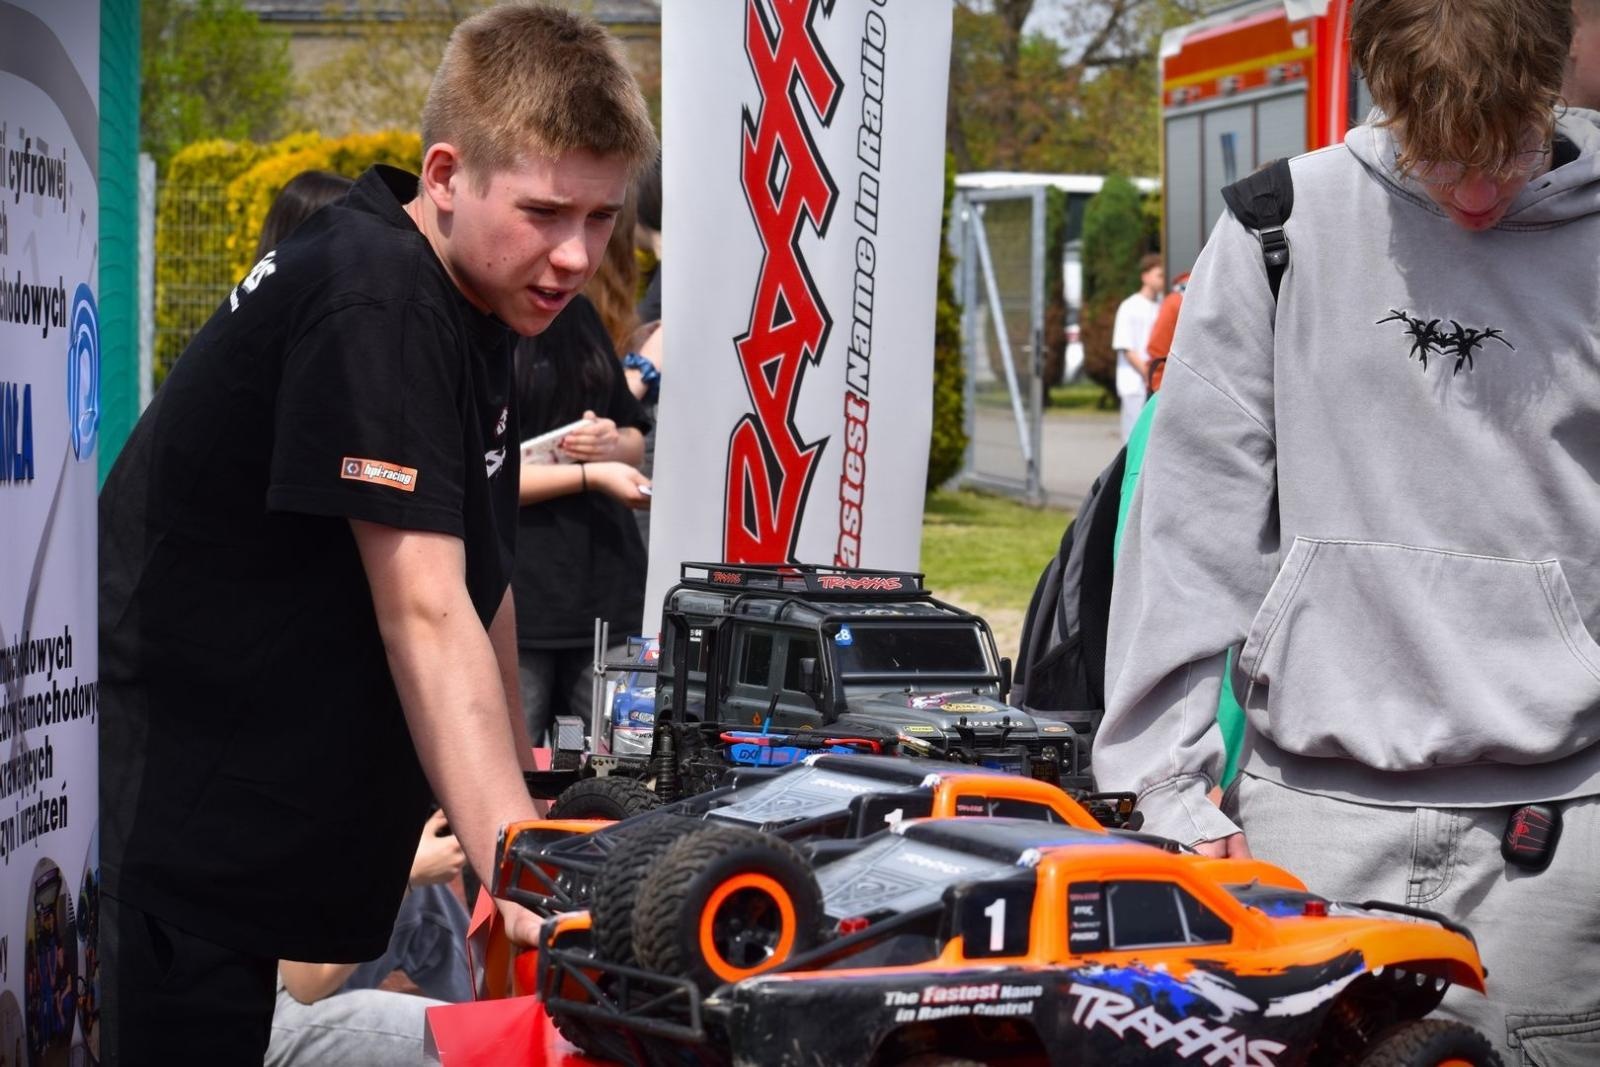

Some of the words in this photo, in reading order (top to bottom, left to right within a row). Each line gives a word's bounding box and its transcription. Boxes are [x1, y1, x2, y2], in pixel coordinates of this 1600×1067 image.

[857, 10, 887, 172] Radio
[9, 137, 67, 214] cyfrowej
[854, 172, 879, 236] In
[846, 236, 876, 397] Name
[818, 576, 903, 591] TRAXXAS
[983, 898, 1006, 952] 1
[885, 991, 919, 1006] The
[1001, 985, 1043, 999] Name
